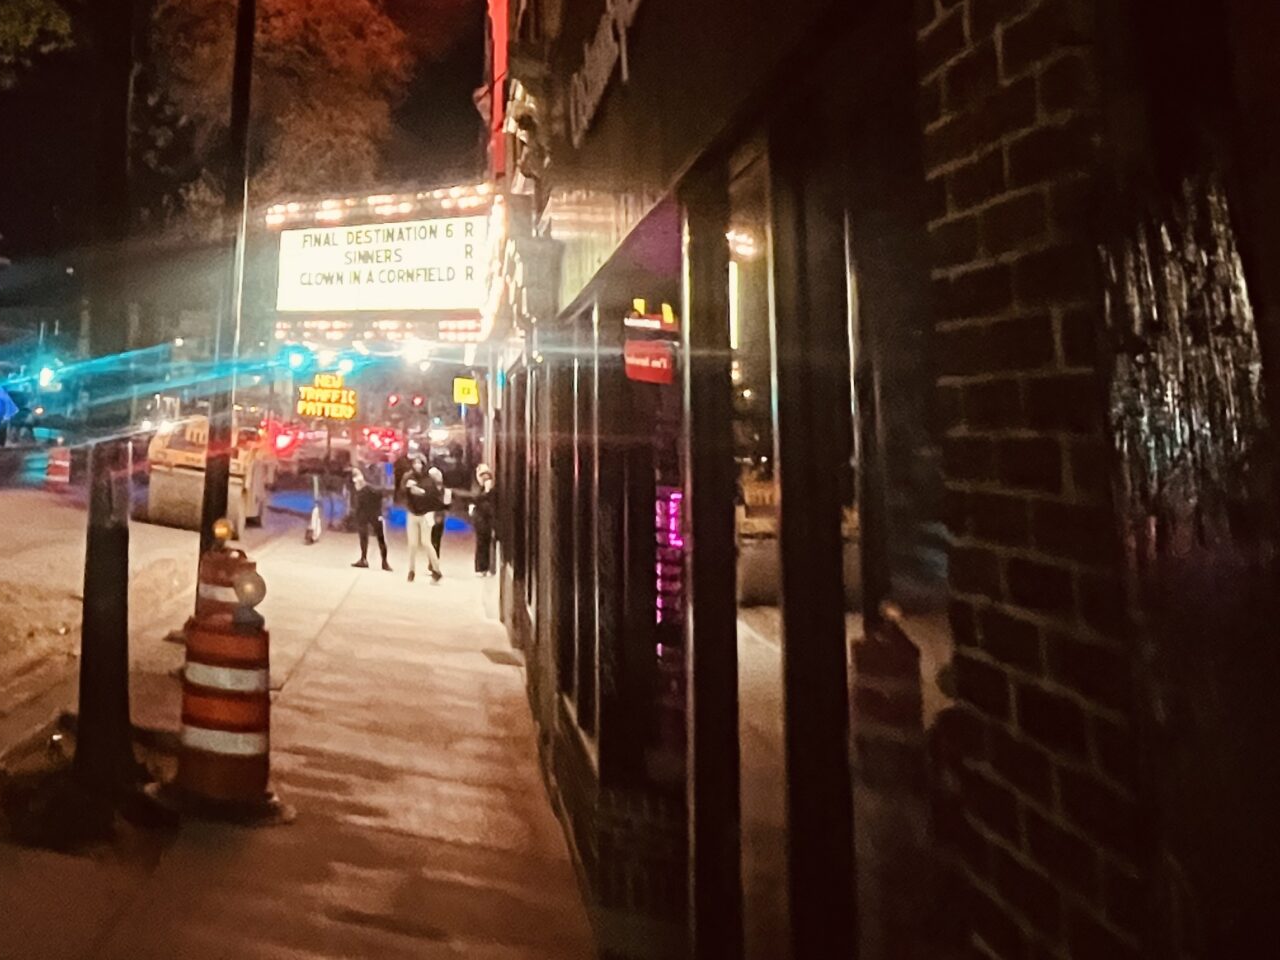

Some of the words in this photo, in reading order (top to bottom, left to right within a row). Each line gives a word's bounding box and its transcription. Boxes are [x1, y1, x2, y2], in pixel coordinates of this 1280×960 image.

[302, 234, 338, 248] FINAL
[346, 224, 437, 245] DESTINATION
[445, 224, 454, 238] 6
[465, 222, 474, 238] R
[344, 248, 403, 265] SINNERS
[465, 244, 474, 260] R
[300, 272, 343, 286] CLOWN
[349, 271, 361, 285] IN
[366, 270, 375, 284] A
[379, 266, 456, 284] CORNFIELD
[465, 266, 475, 281] R
[315, 374, 343, 389] NEW
[299, 387, 356, 404] TRAFFIC
